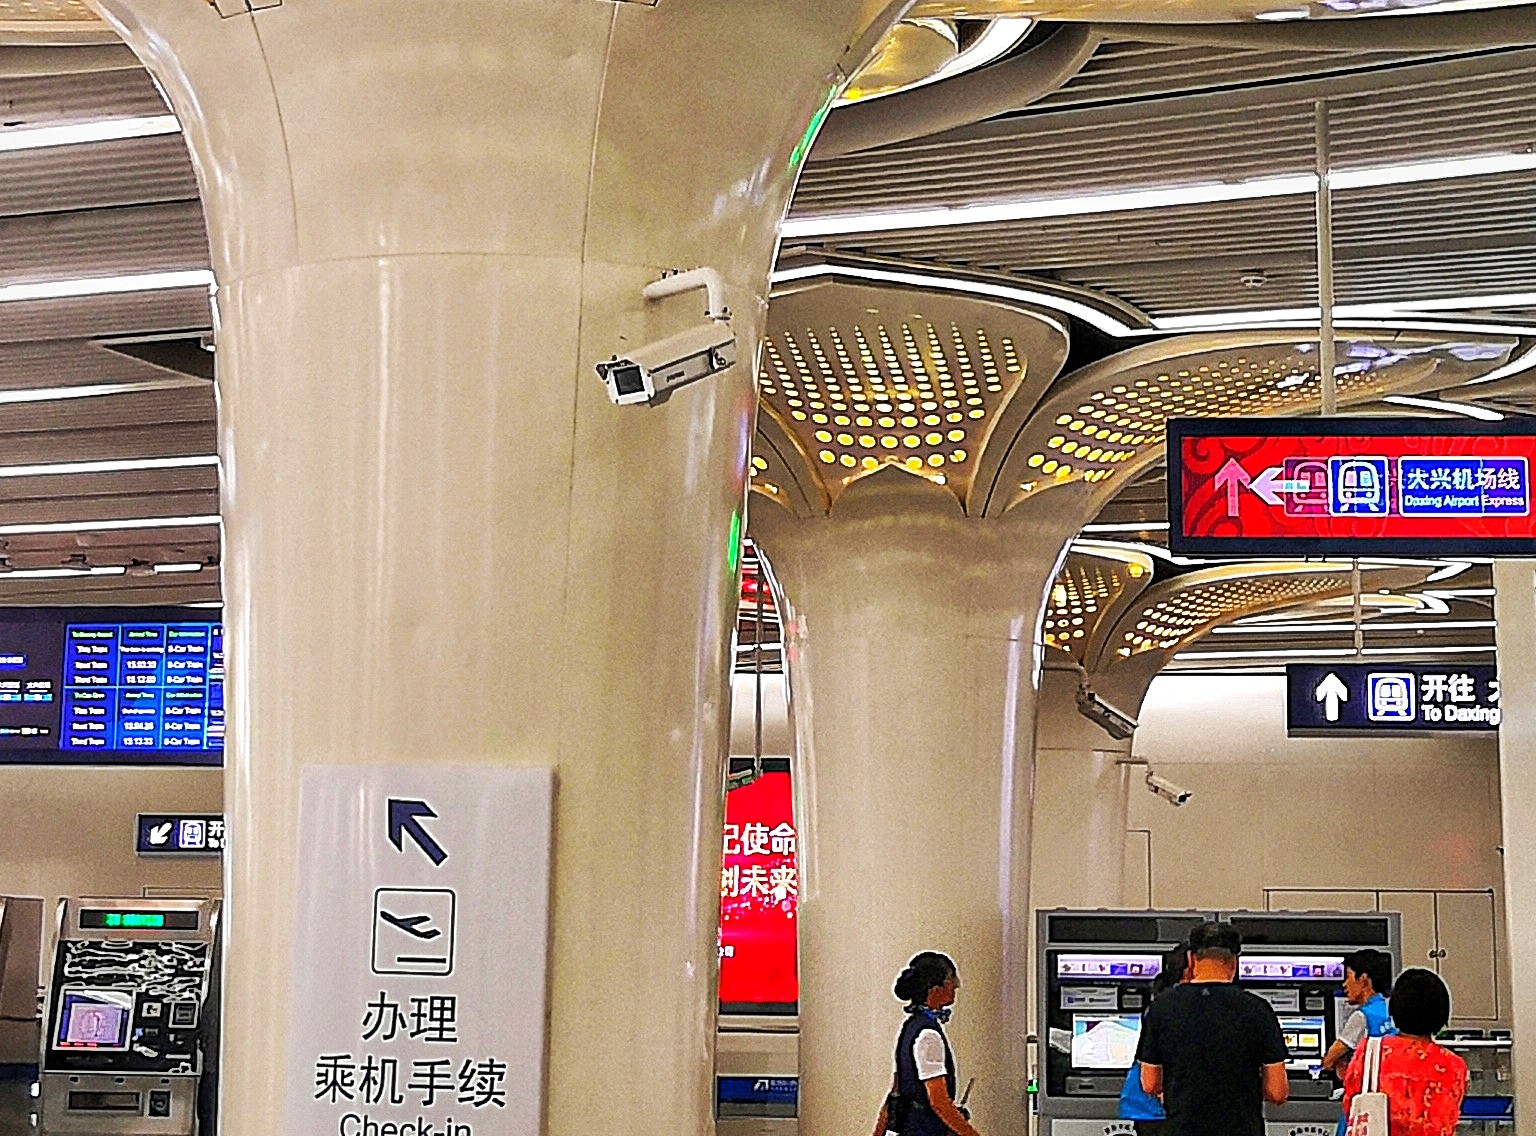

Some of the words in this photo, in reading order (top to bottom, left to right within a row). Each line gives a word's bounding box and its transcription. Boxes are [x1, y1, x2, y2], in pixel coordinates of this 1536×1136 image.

[1408, 468, 1520, 489] 大兴机场线
[1443, 495, 1479, 508] Airport
[1483, 495, 1524, 508] Express
[1421, 674, 1475, 702] 开往
[1421, 705, 1442, 721] To
[1445, 705, 1500, 725] Daxing
[362, 991, 457, 1042] 办理
[315, 1055, 506, 1107] 乘机手续
[340, 1114, 472, 1136] Check-in
